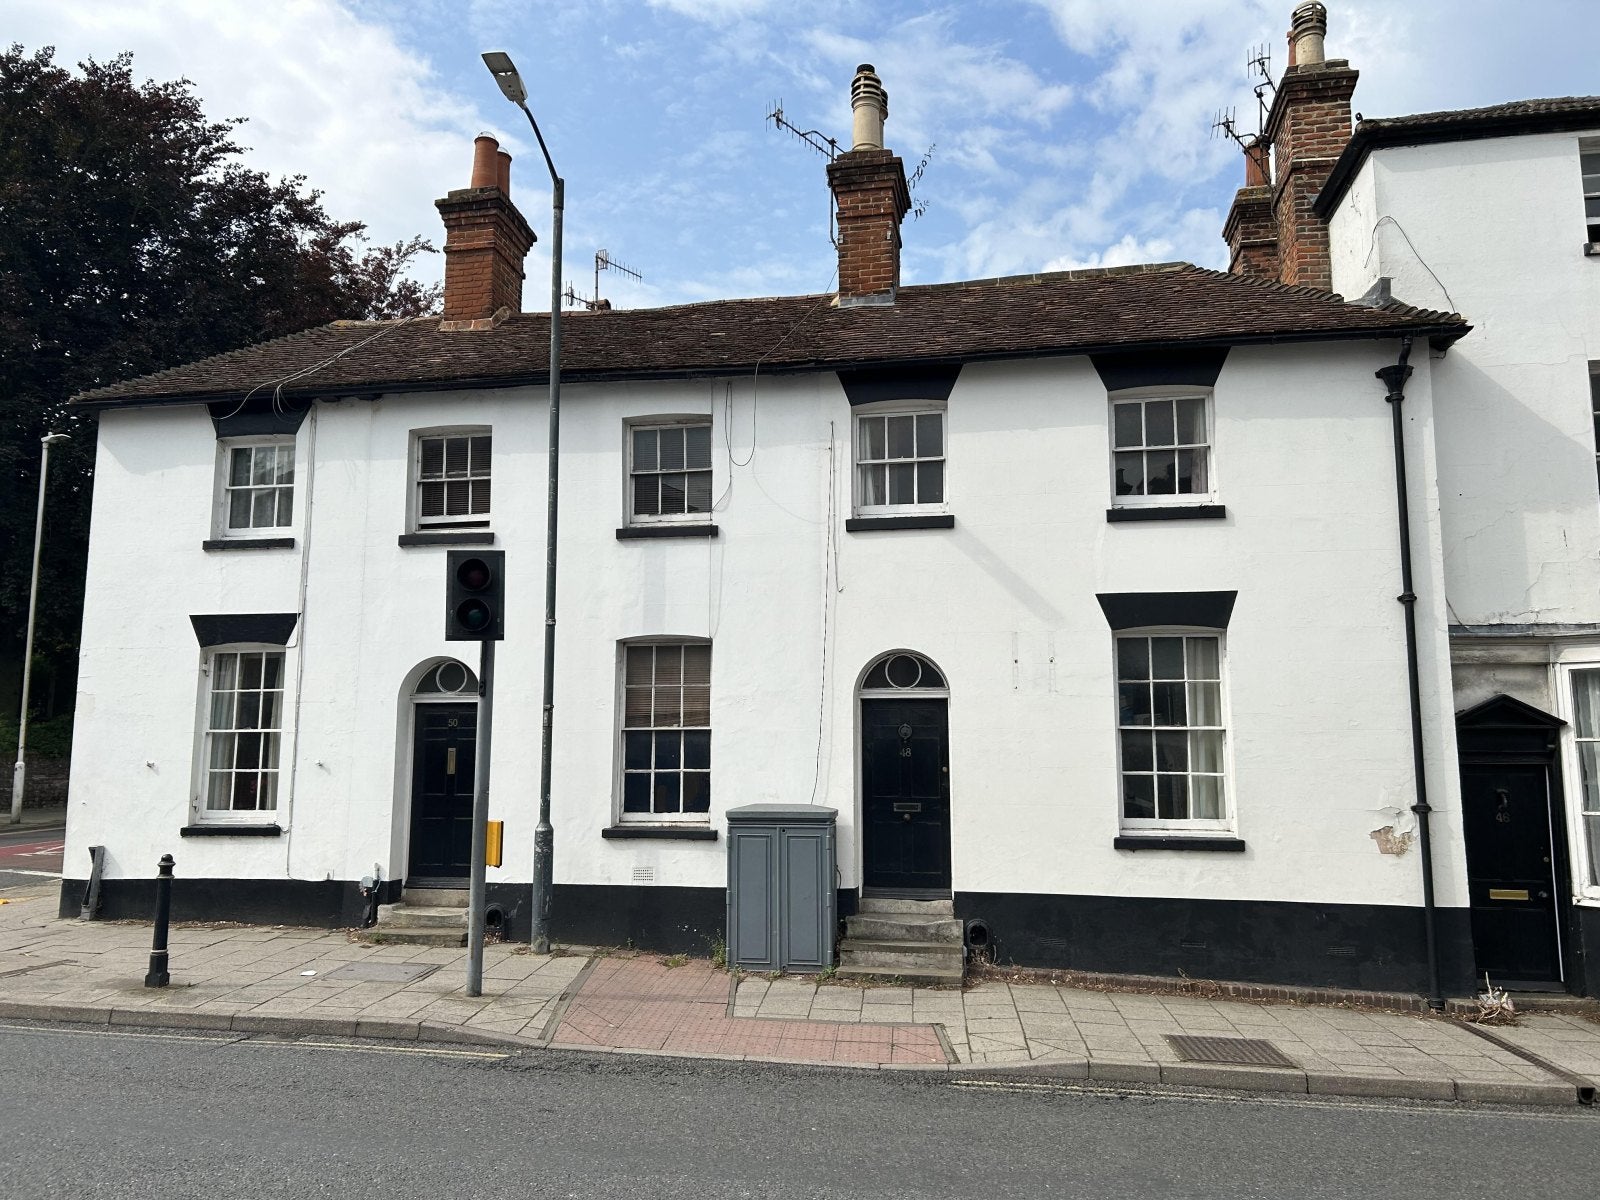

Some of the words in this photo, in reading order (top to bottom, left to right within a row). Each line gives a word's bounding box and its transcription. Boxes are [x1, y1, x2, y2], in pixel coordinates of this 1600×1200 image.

[448, 718, 459, 727] 50
[899, 747, 912, 758] 48
[1496, 812, 1511, 823] 46
